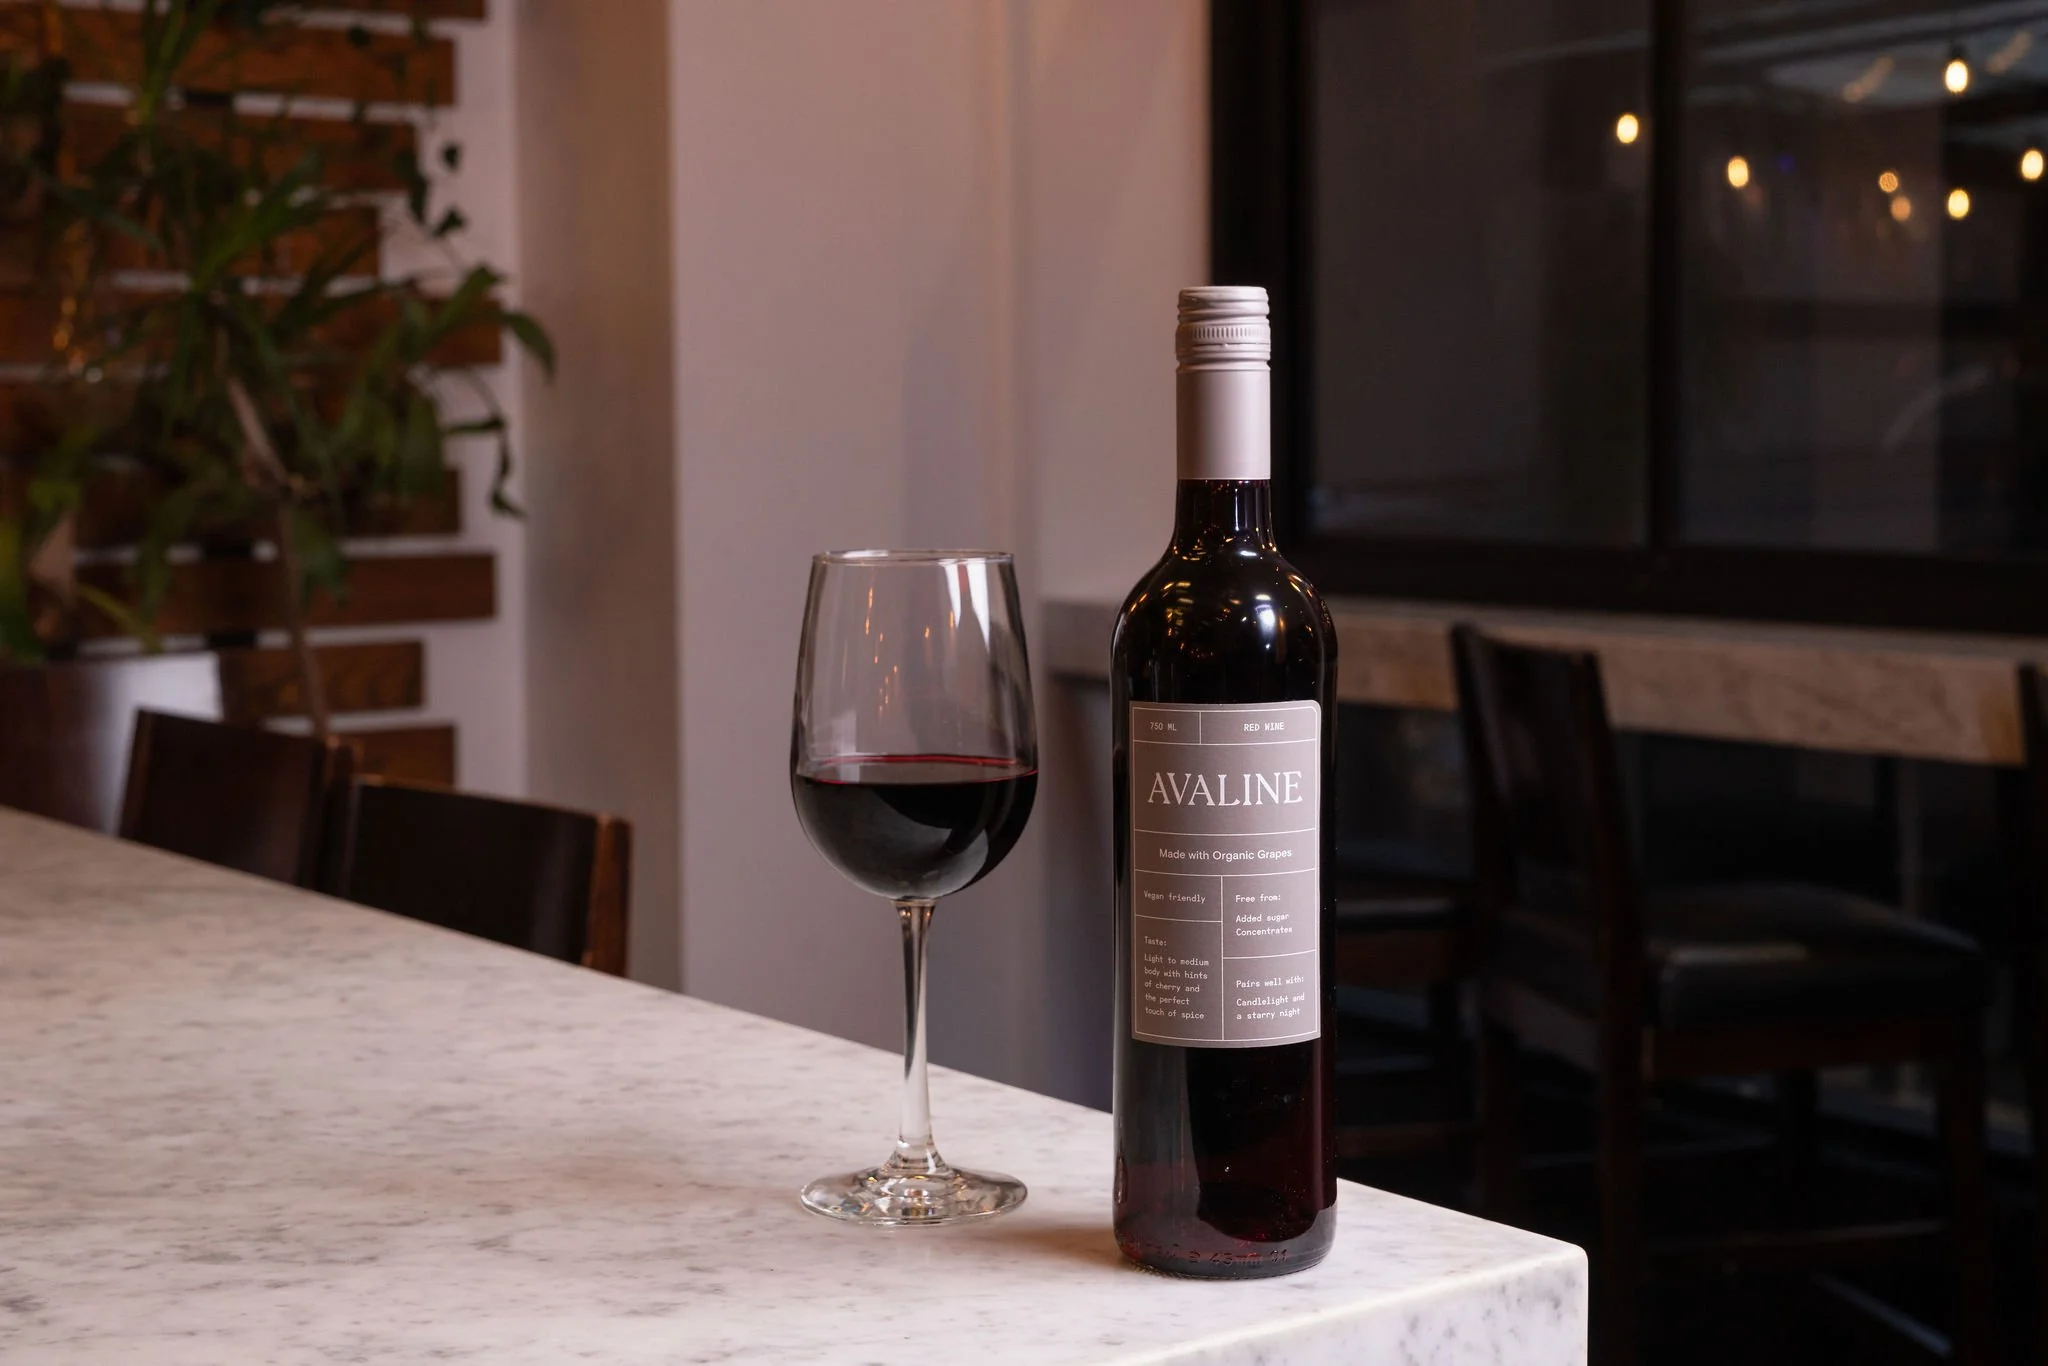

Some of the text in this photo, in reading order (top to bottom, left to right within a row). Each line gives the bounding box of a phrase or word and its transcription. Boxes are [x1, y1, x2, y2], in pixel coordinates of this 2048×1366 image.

[1150, 721, 1177, 731] 750 ML
[1243, 722, 1285, 732] RED WINE
[1147, 771, 1303, 806] AVALINE
[1159, 849, 1292, 862] Made with Organic Grapes
[1143, 890, 1206, 904] Vegan friendly
[1235, 893, 1282, 903] Free from:
[1236, 913, 1290, 923] Added sugar
[1236, 926, 1293, 936] Concentrates
[1143, 935, 1167, 946] Taste:
[1143, 954, 1209, 966] Light to medium
[1143, 966, 1208, 979] body with hints
[1155, 982, 1181, 992] cherry
[1185, 985, 1200, 993] and
[1236, 976, 1304, 988] Pairs well with:
[1145, 993, 1190, 1005] the perfect
[1236, 994, 1305, 1007] Candlelight and
[1145, 1007, 1205, 1020] touch of spice
[1247, 1010, 1276, 1020] starry
[1279, 1008, 1301, 1018] night
